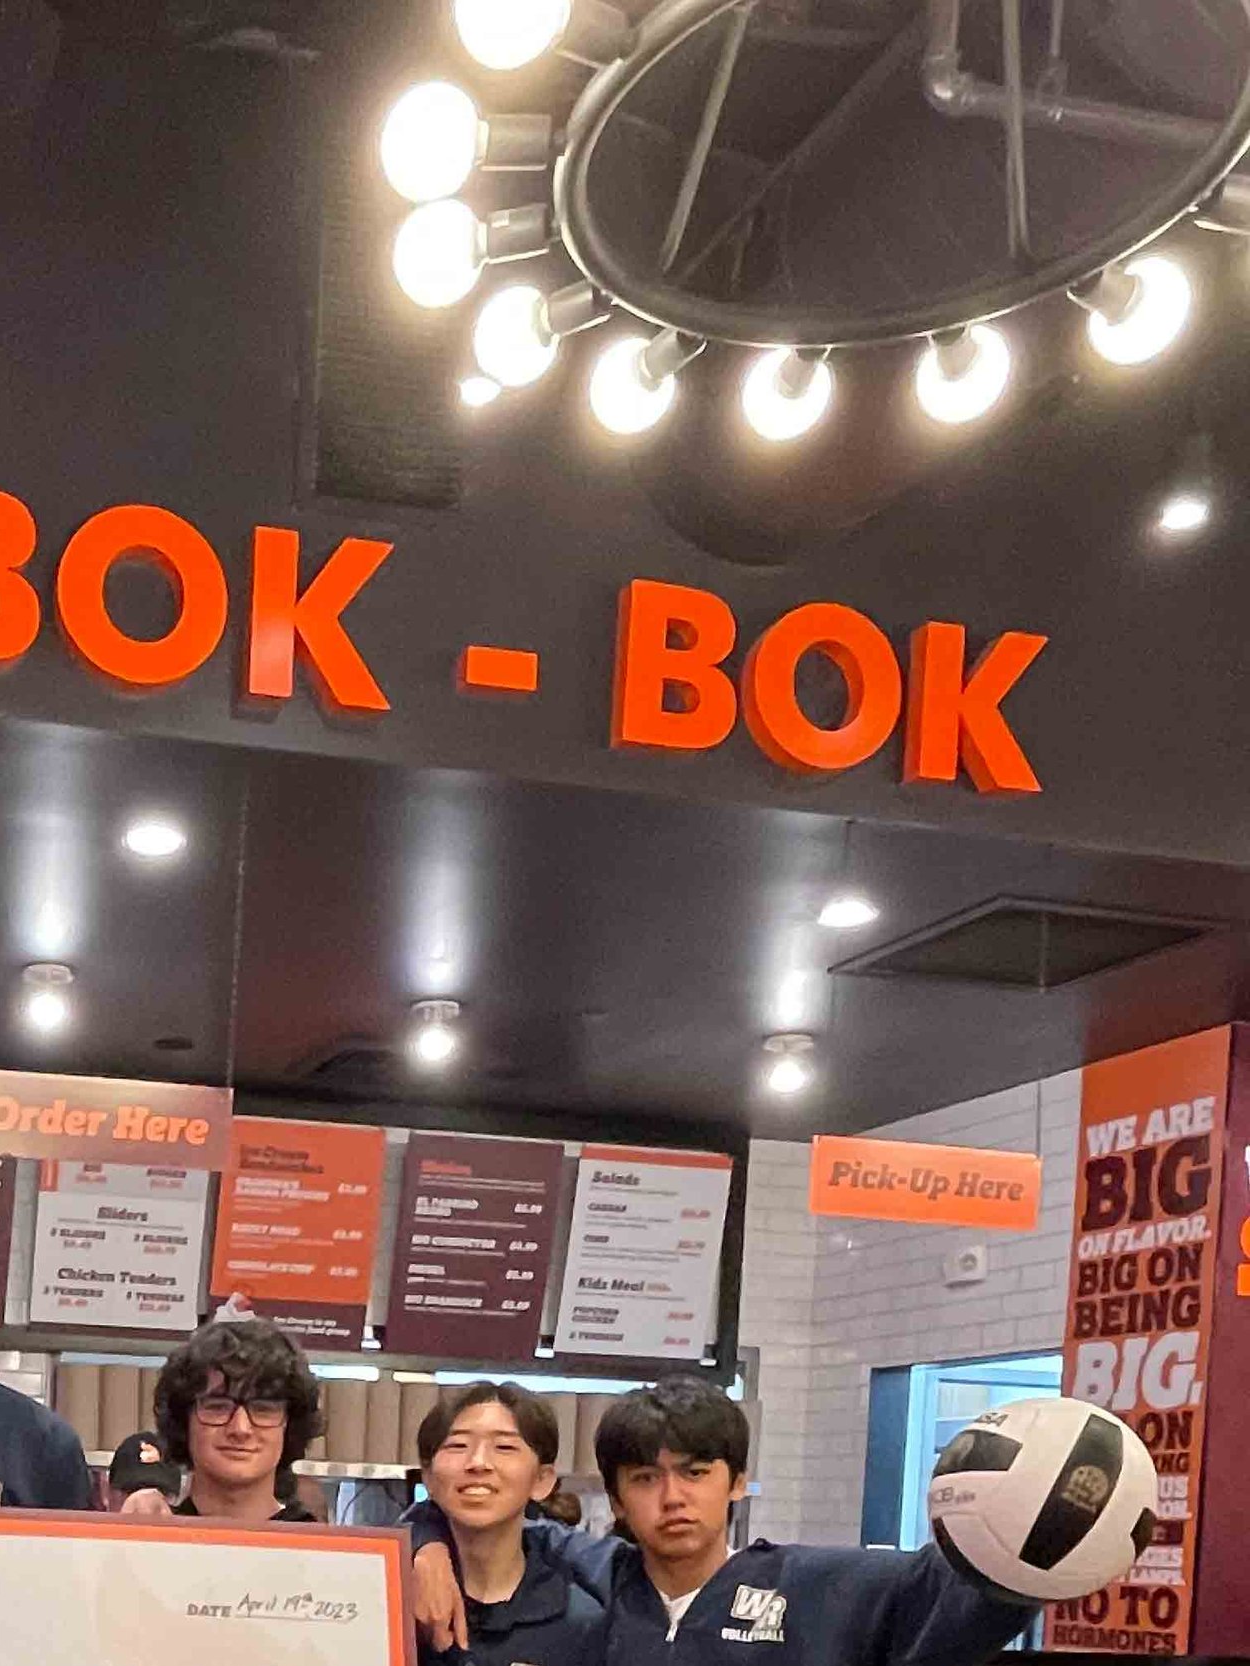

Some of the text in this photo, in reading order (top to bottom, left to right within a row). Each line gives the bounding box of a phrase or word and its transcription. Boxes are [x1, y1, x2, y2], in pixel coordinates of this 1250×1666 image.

[611, 578, 1049, 794] BOK
[113, 1105, 210, 1145] Here
[1086, 1096, 1216, 1158] WE ARE
[592, 1170, 641, 1185] Salads
[828, 1161, 1024, 1200] Pick-Up Here
[1081, 1135, 1212, 1232] BIG
[97, 1206, 148, 1222] Sliders
[1078, 1214, 1212, 1260] ON FLAVOR.
[58, 1268, 177, 1286] Chicken Tenders
[611, 1279, 645, 1292] Meal
[1077, 1243, 1204, 1298] BIG ON
[1074, 1285, 1201, 1339] BEING
[1137, 1411, 1194, 1450] ON
[187, 1603, 231, 1618] DATE
[238, 1593, 275, 1616] April
[315, 1600, 358, 1620] 2023
[730, 1584, 787, 1632] WR
[1120, 1586, 1179, 1628] TO
[1053, 1624, 1176, 1655] HORMONES
